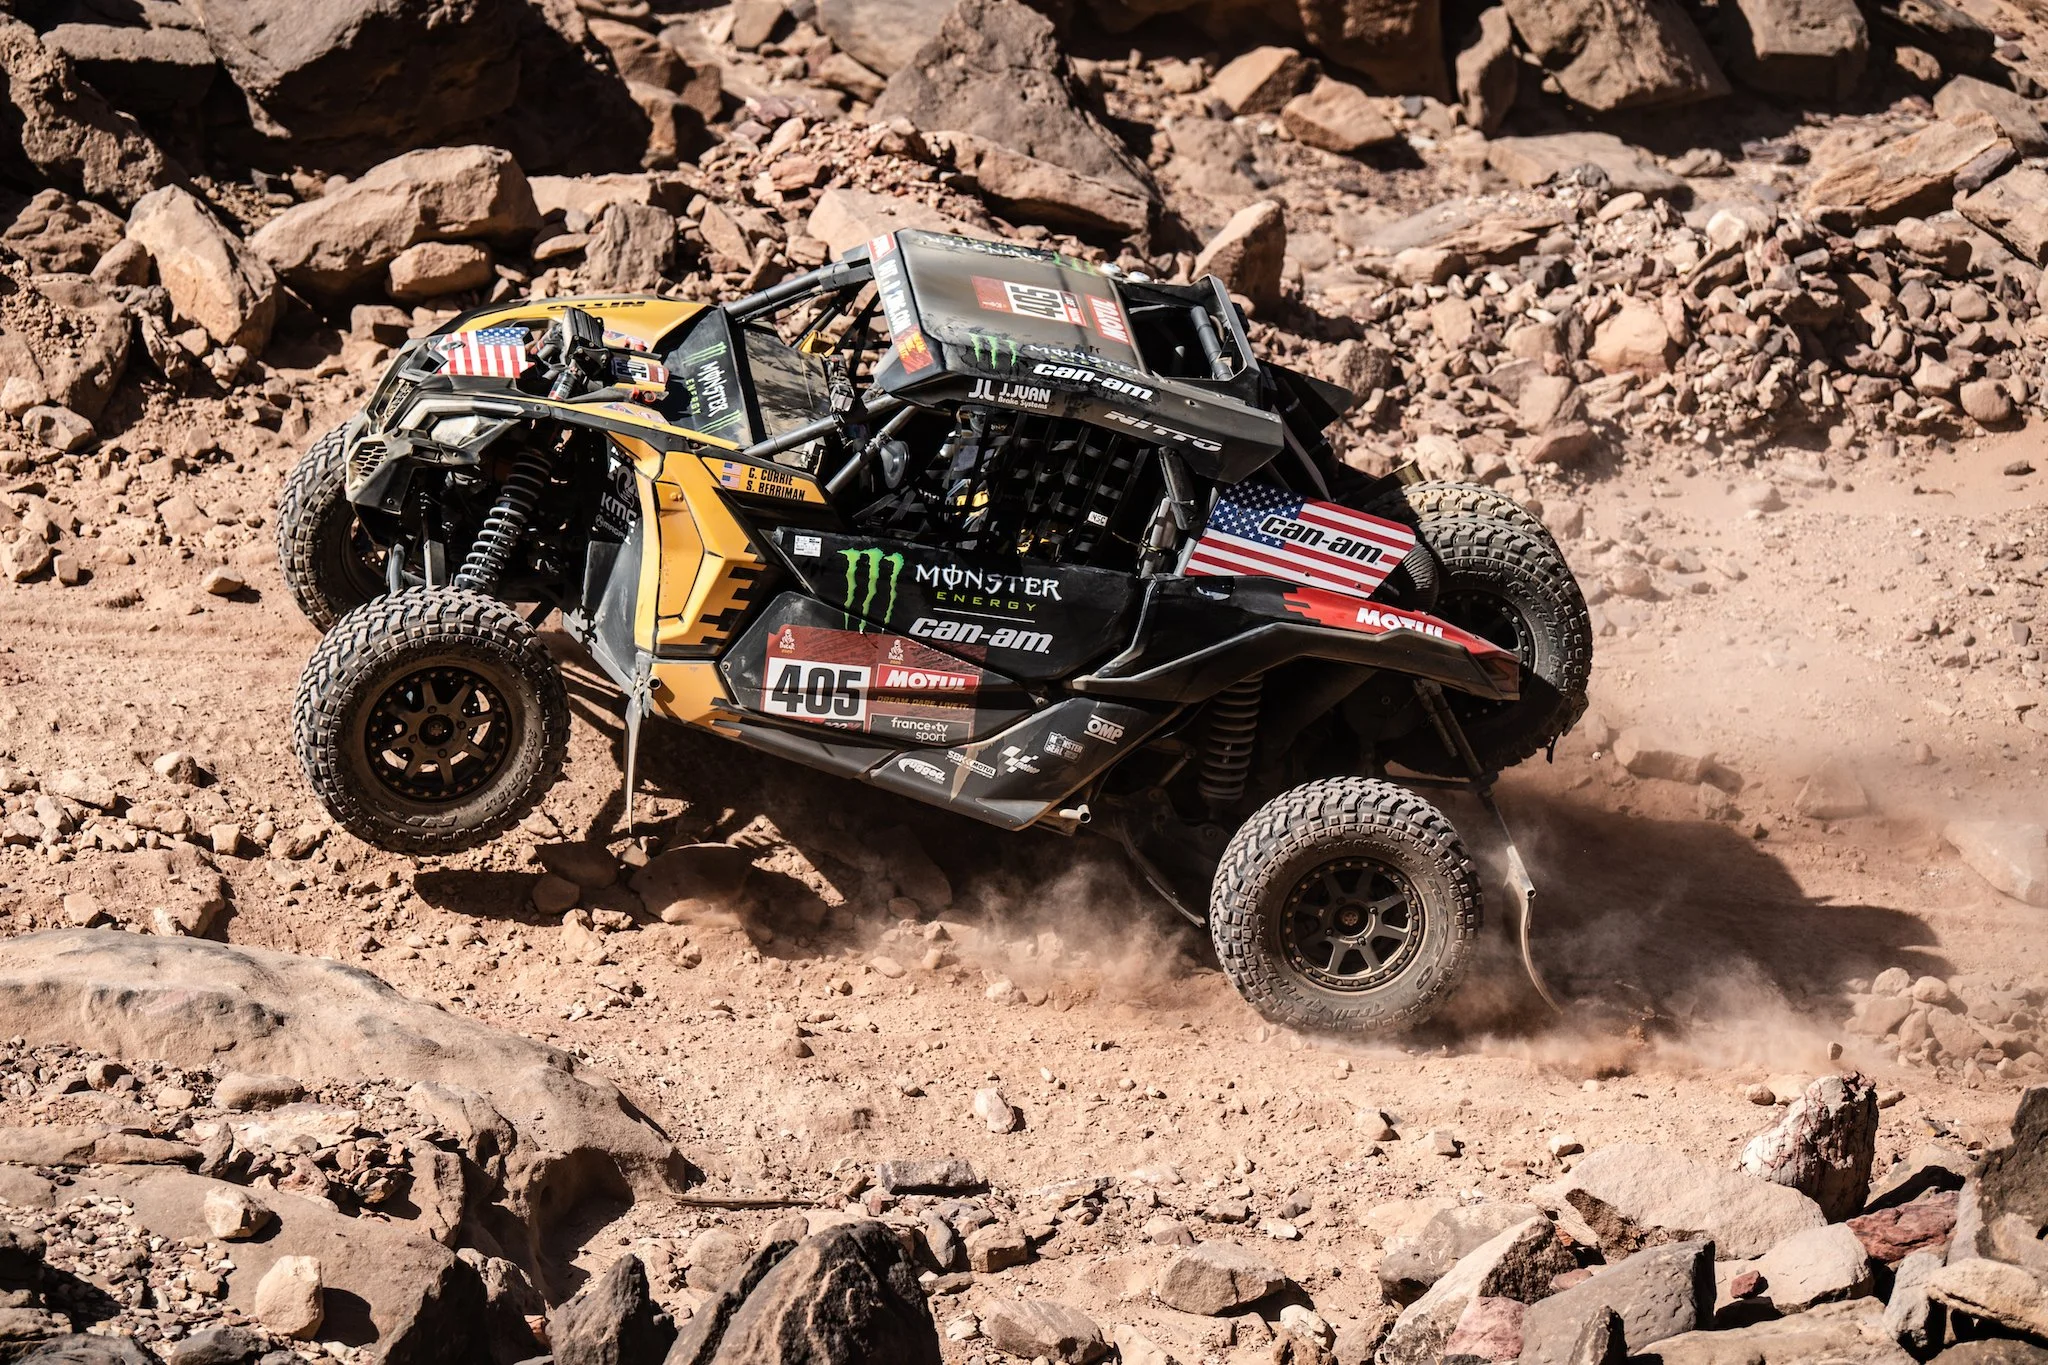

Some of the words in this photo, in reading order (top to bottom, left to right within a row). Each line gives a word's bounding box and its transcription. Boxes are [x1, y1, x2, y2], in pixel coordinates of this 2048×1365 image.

[1010, 285, 1064, 318] 405
[1091, 297, 1130, 343] MOTUL
[685, 378, 702, 415] ENERGY
[696, 360, 729, 418] MONSTER
[1033, 363, 1152, 401] can-am
[997, 397, 1019, 406] Brake
[1020, 400, 1048, 409] Systems
[1104, 410, 1223, 452] NITTO
[746, 480, 755, 491] S.
[758, 483, 806, 501] BERRIMAN
[761, 470, 793, 486] CURRIE
[1261, 516, 1385, 565] can-am
[916, 563, 1063, 601] MONSTER
[936, 591, 1037, 612] ENERGY
[909, 617, 1054, 654] can-am
[772, 664, 862, 716] 405
[885, 670, 966, 691] MOTUL
[915, 731, 947, 743] sport
[1087, 718, 1124, 741] OMP
[946, 749, 965, 765] SBK
[971, 762, 995, 775] MOTUL
